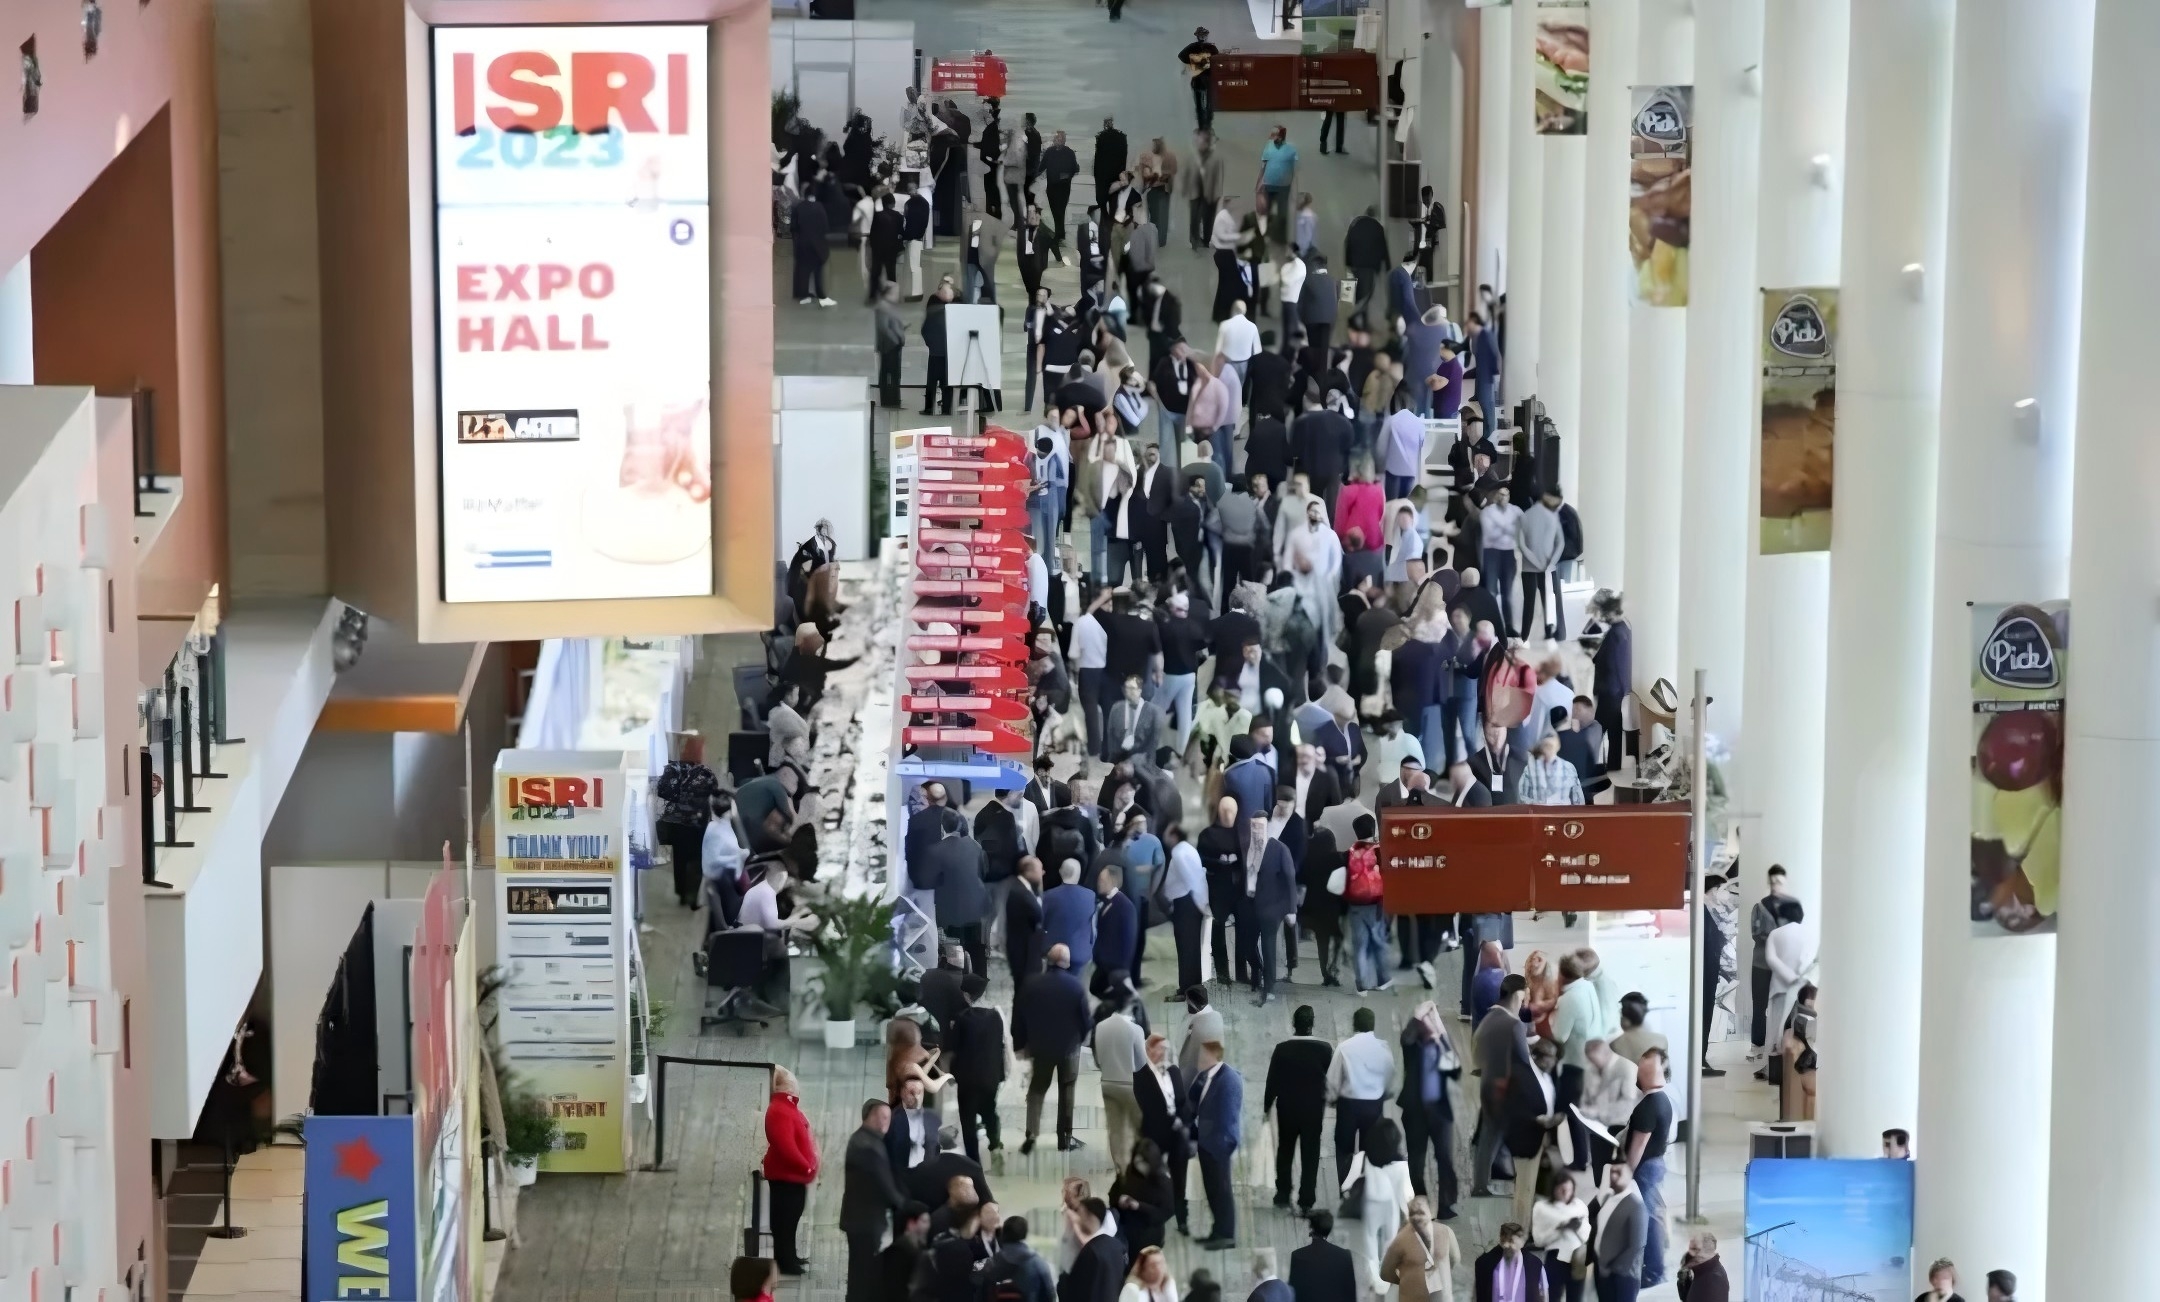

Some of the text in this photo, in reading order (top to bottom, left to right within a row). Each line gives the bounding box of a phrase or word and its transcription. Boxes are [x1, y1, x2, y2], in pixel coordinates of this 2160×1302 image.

[453, 50, 688, 136] ISRI
[456, 125, 624, 168] 2023
[456, 263, 615, 302] EXPO
[457, 313, 610, 352] HALL
[1989, 639, 2051, 676] Pick
[508, 777, 604, 808] ISRI
[507, 834, 563, 859] THANK
